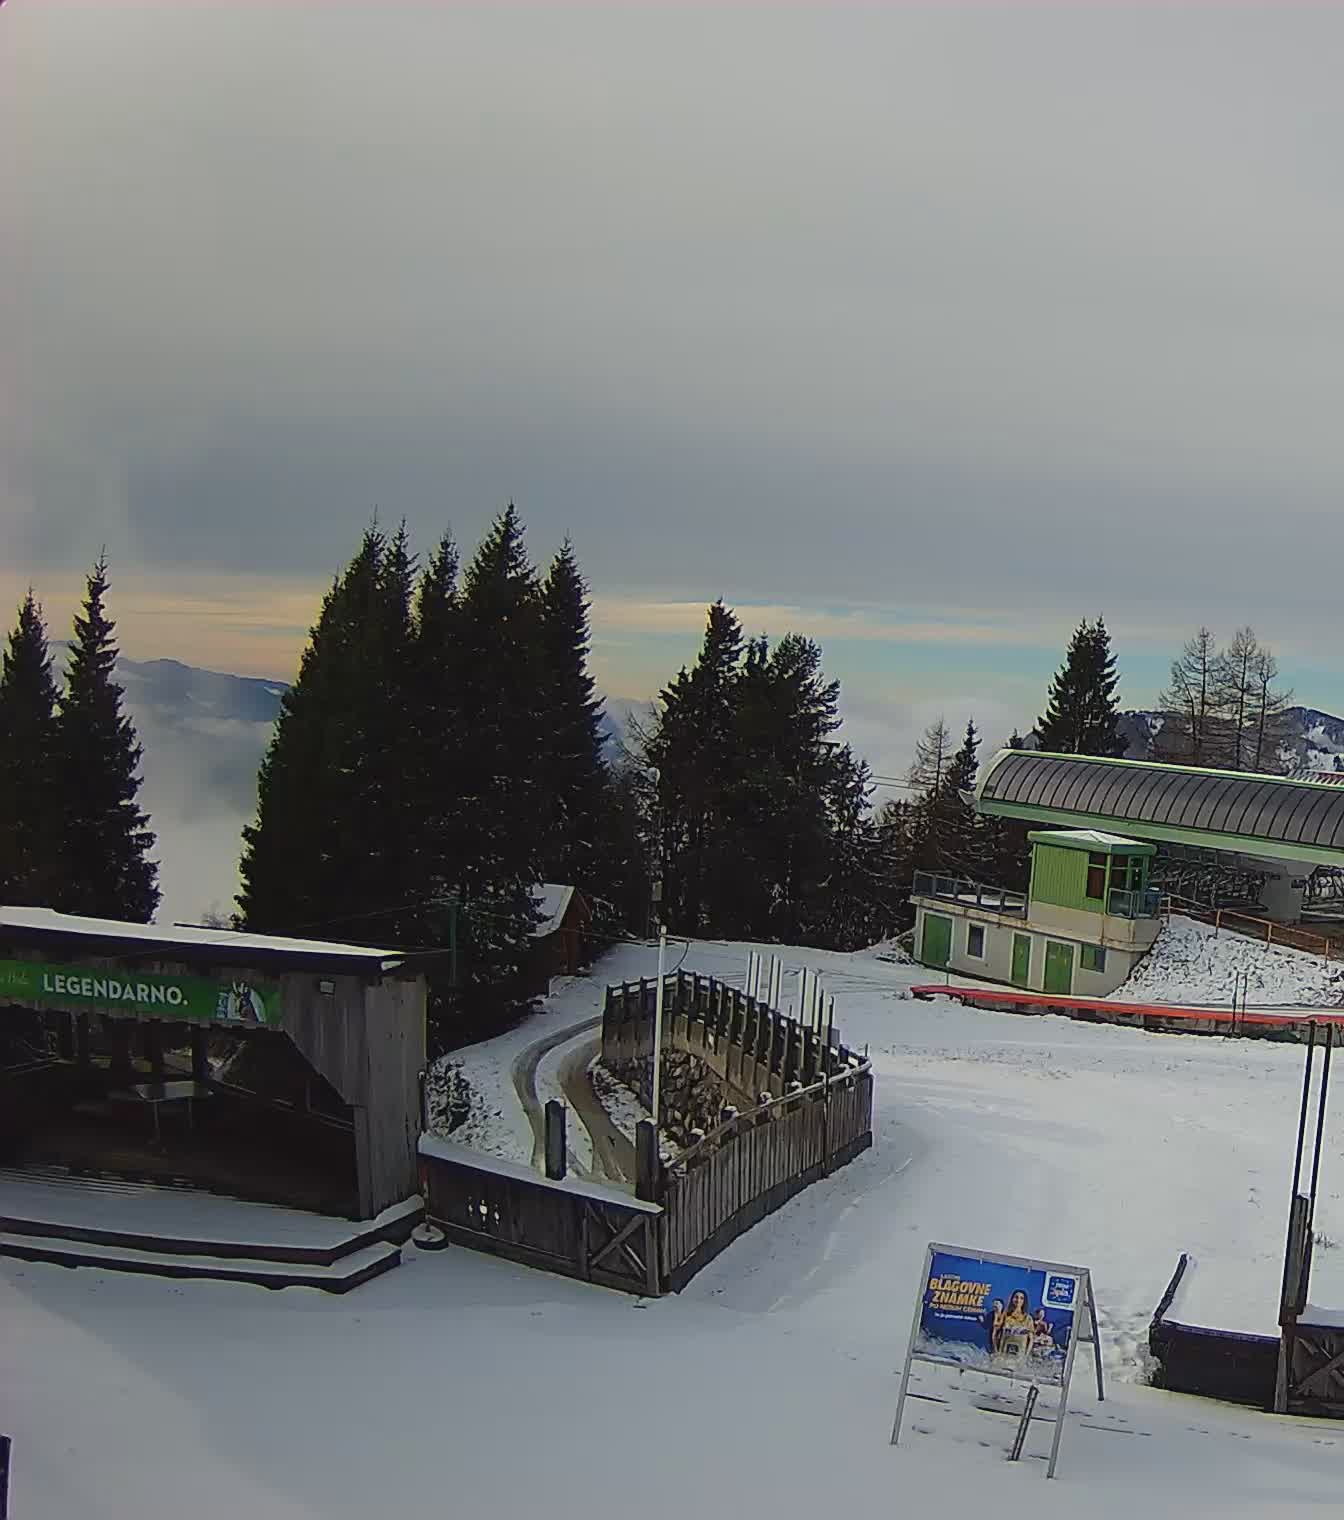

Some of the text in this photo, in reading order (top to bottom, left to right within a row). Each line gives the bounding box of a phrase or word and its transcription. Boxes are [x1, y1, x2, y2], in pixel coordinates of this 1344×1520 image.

[43, 973, 189, 1006] LEGENDARNO.
[929, 1278, 992, 1296] BLAGOVNE
[932, 1291, 985, 1307] ZNAMKE
